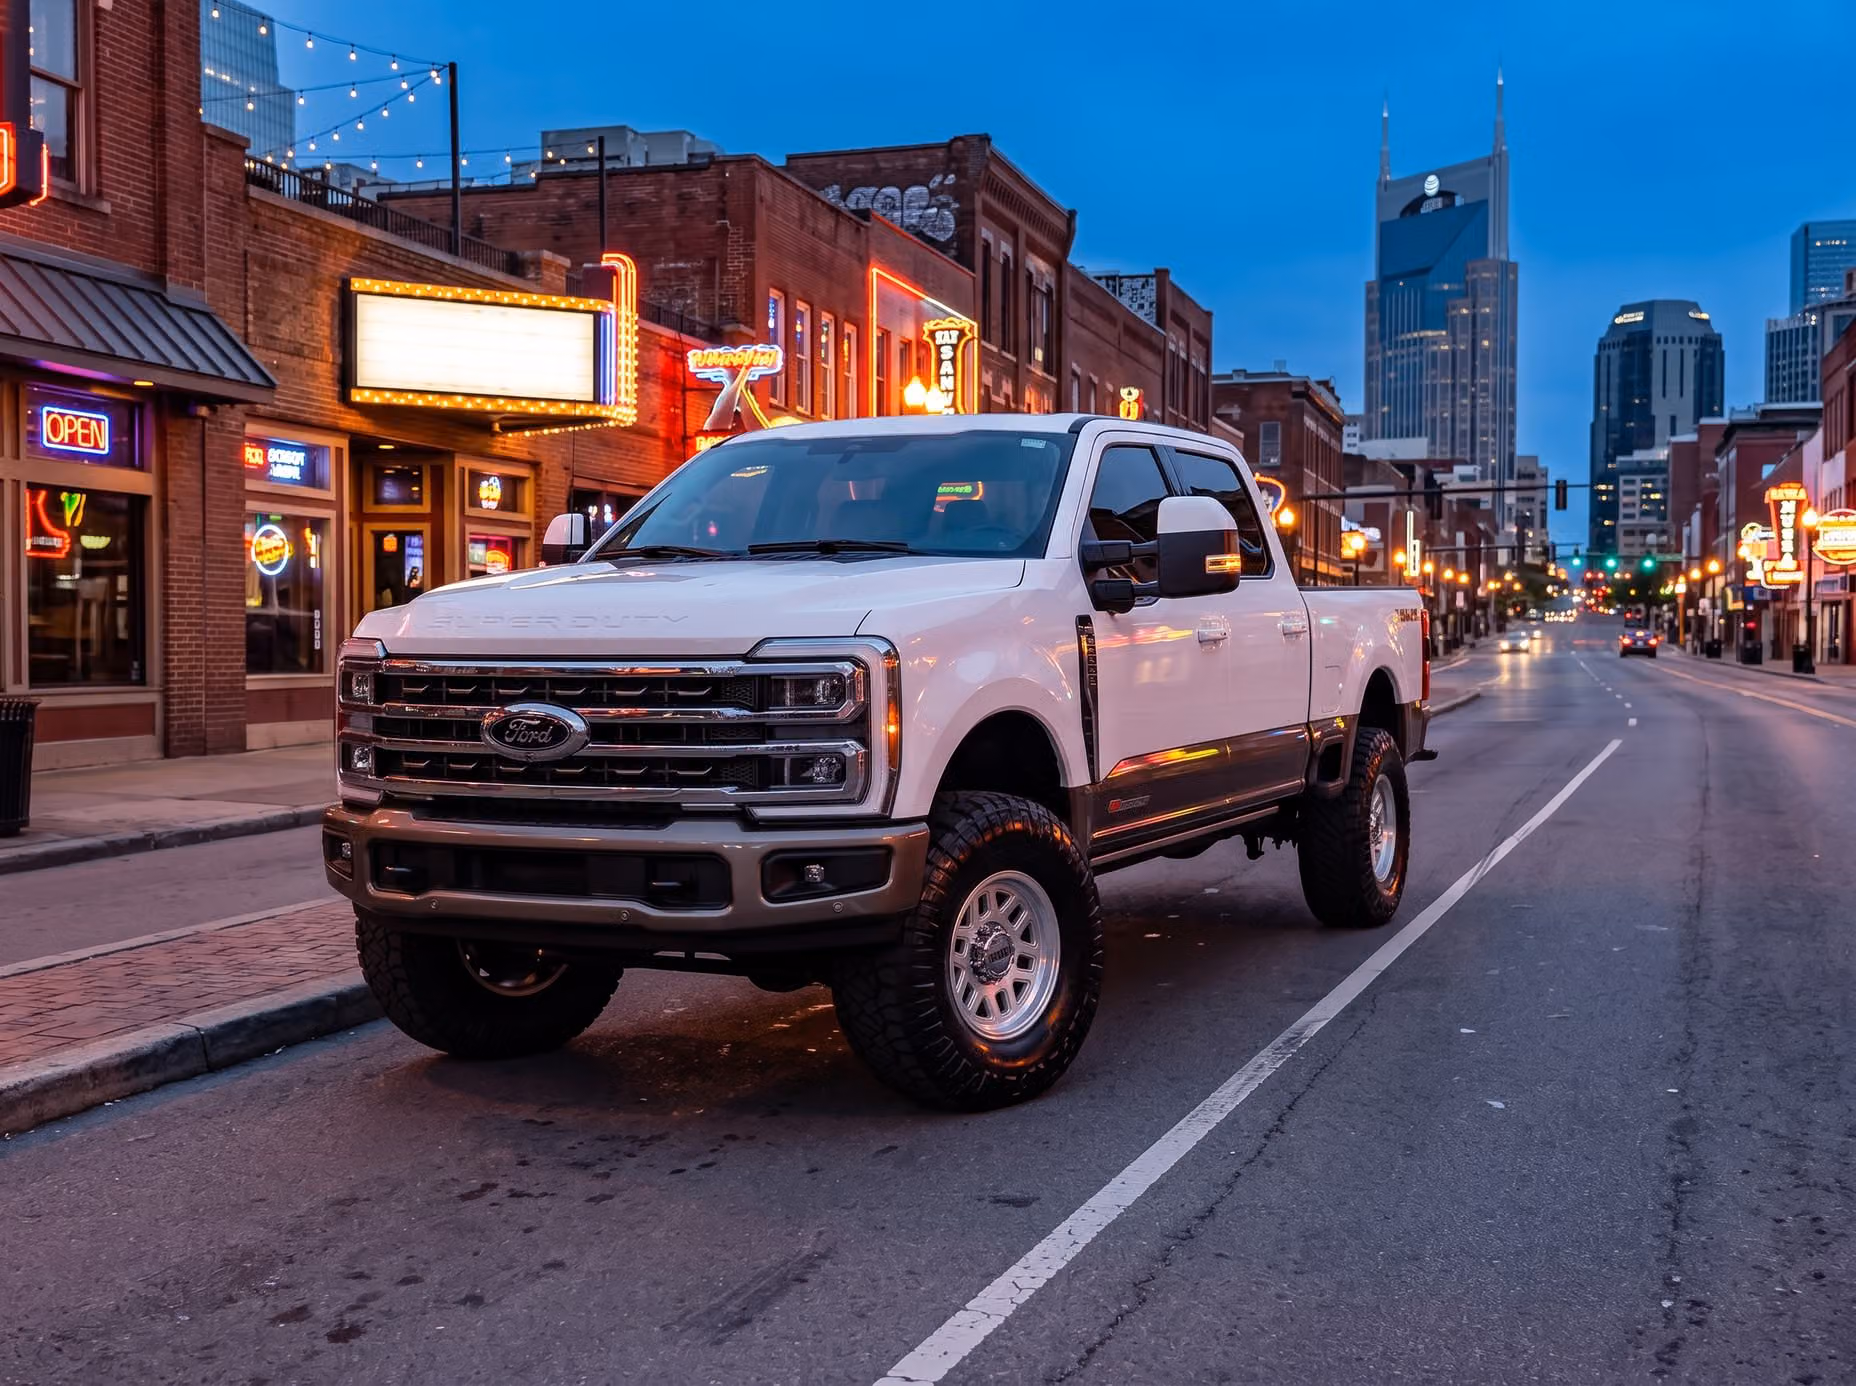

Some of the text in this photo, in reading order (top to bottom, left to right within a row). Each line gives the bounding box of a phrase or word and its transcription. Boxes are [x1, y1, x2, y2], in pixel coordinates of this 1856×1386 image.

[46, 413, 105, 449] OPEN
[427, 614, 689, 629] SUPER DUTY
[504, 718, 553, 743] Ford
